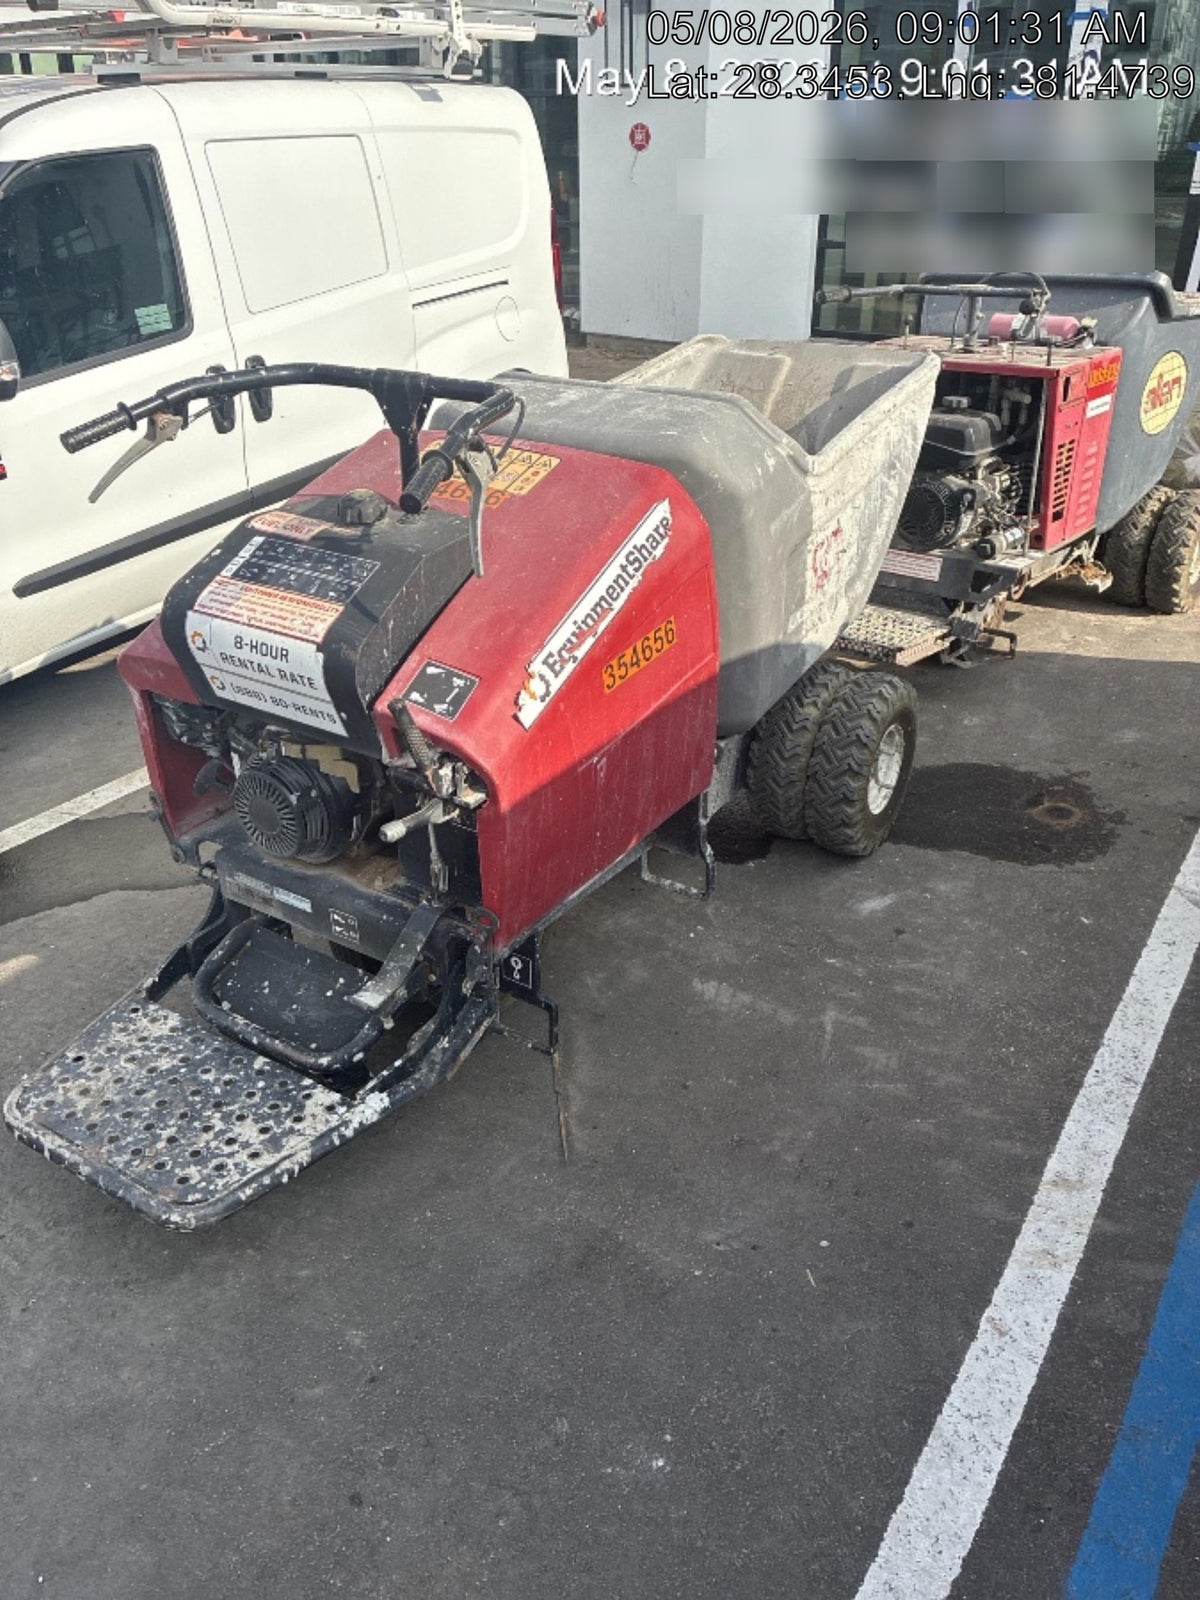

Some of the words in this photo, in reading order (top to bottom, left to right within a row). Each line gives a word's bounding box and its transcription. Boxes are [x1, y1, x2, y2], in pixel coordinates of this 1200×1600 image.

[233, 635, 290, 664] 8-HOUR
[604, 620, 676, 691] 354656
[219, 652, 275, 679] RENTAL
[277, 668, 319, 691] RATE
